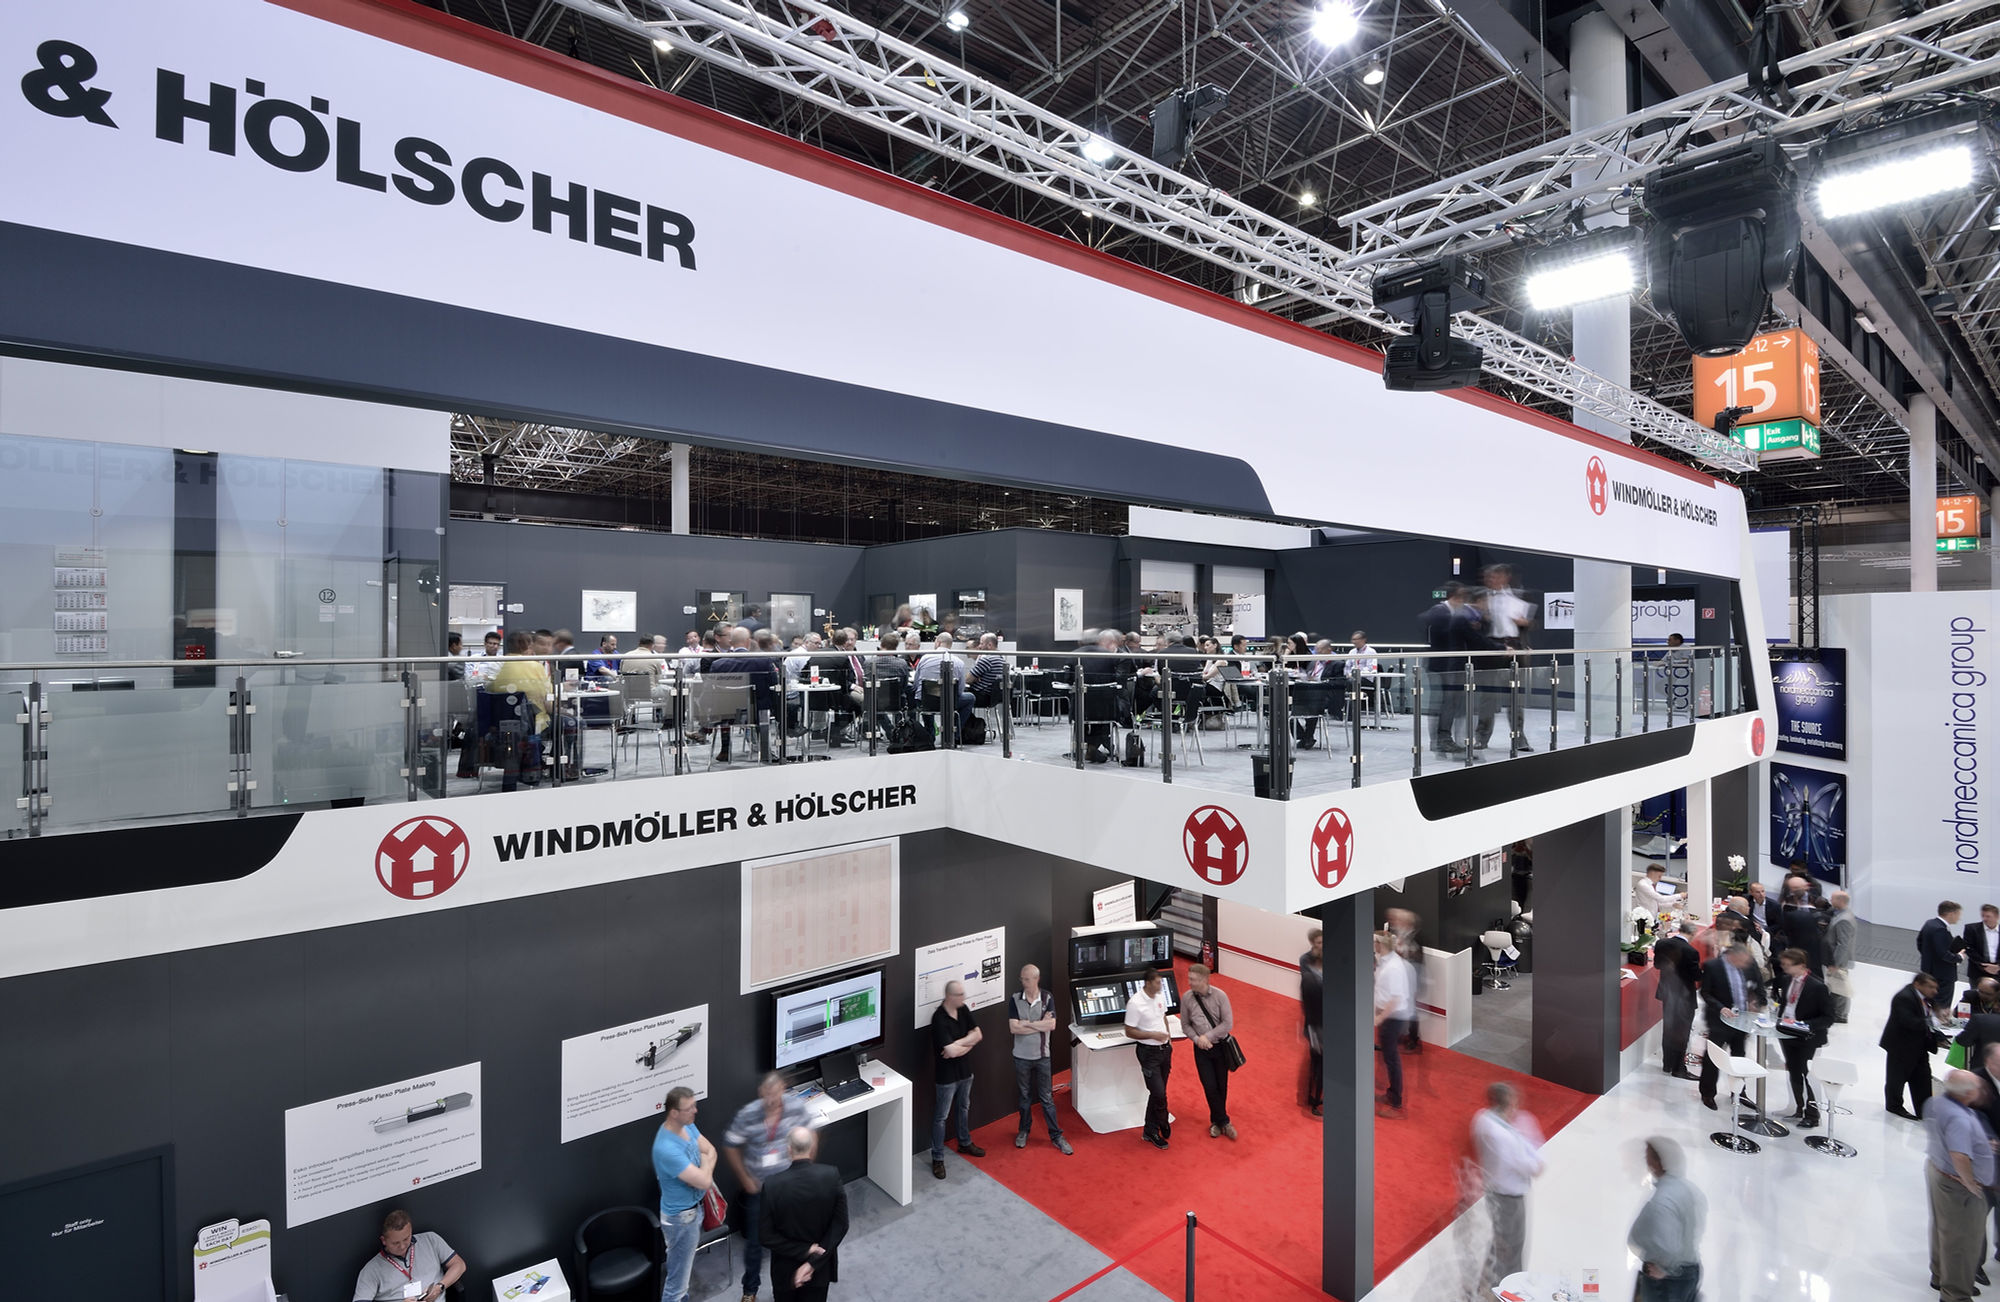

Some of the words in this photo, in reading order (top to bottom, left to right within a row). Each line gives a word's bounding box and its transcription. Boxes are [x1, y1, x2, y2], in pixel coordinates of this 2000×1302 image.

[21, 39, 119, 129] &
[155, 68, 698, 271] HÖLSCHER
[1714, 361, 1777, 414] 15
[1803, 361, 1817, 415] 15
[1766, 427, 1781, 436] Exit
[1767, 434, 1799, 444] Ausgang
[1612, 480, 1673, 515] WINDMÖLLER
[1673, 498, 1680, 517] &
[1680, 498, 1718, 526] HÖLSCHER
[1936, 509, 1965, 534] 15
[1632, 605, 1681, 622] group
[1950, 616, 1987, 687] group
[1942, 692, 1980, 874] nordmeccanica
[493, 806, 738, 862] WINDMÖLLER
[747, 802, 767, 827] &
[775, 784, 917, 823] HÖLSCHER
[336, 1096, 374, 1110] Press-Side
[374, 1091, 394, 1101] Flexo
[394, 1086, 412, 1096] Plate
[412, 1080, 437, 1091] Making
[65, 1220, 78, 1229] Staff
[211, 1225, 228, 1235] WIN
[205, 1239, 221, 1247] EACH
[221, 1235, 233, 1243] DAY
